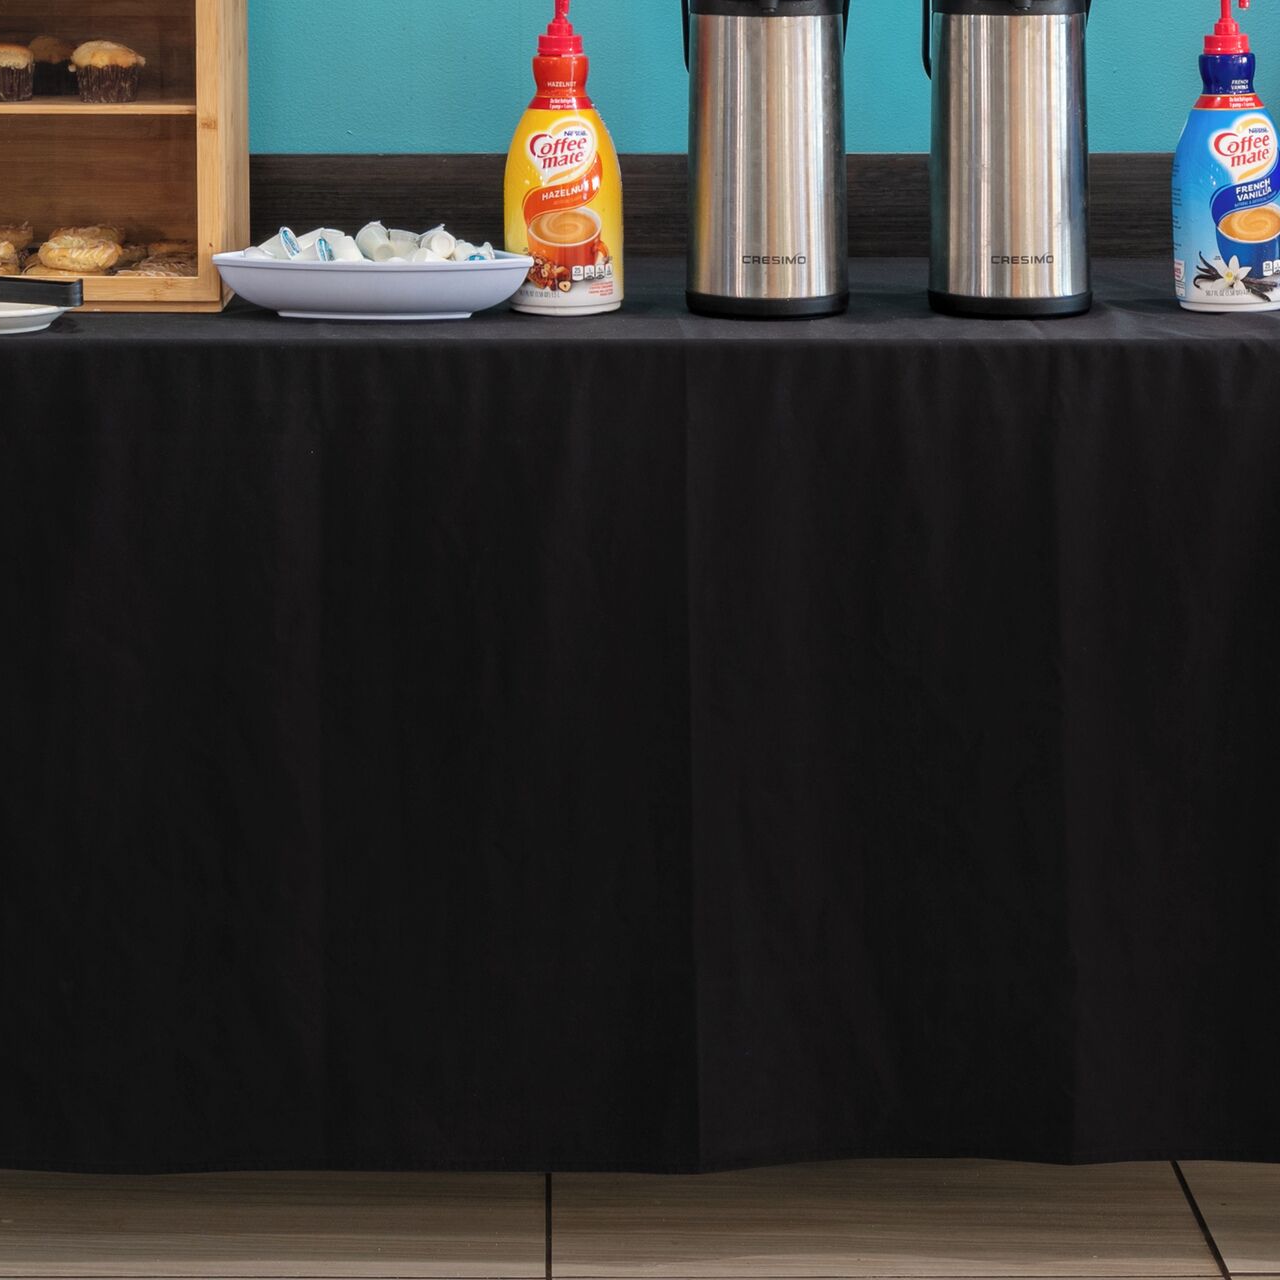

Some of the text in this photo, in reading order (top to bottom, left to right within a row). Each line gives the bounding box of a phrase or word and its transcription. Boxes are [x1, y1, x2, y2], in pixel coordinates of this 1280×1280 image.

[529, 133, 587, 158] Coffee
[1214, 132, 1270, 157] Coffee
[542, 151, 584, 169] mate
[1231, 148, 1269, 167] mate
[1236, 178, 1271, 194] FRENCH
[1237, 187, 1272, 201] VANILLA
[742, 253, 807, 265] CRESIMO
[991, 253, 1054, 265] CRESIMO
